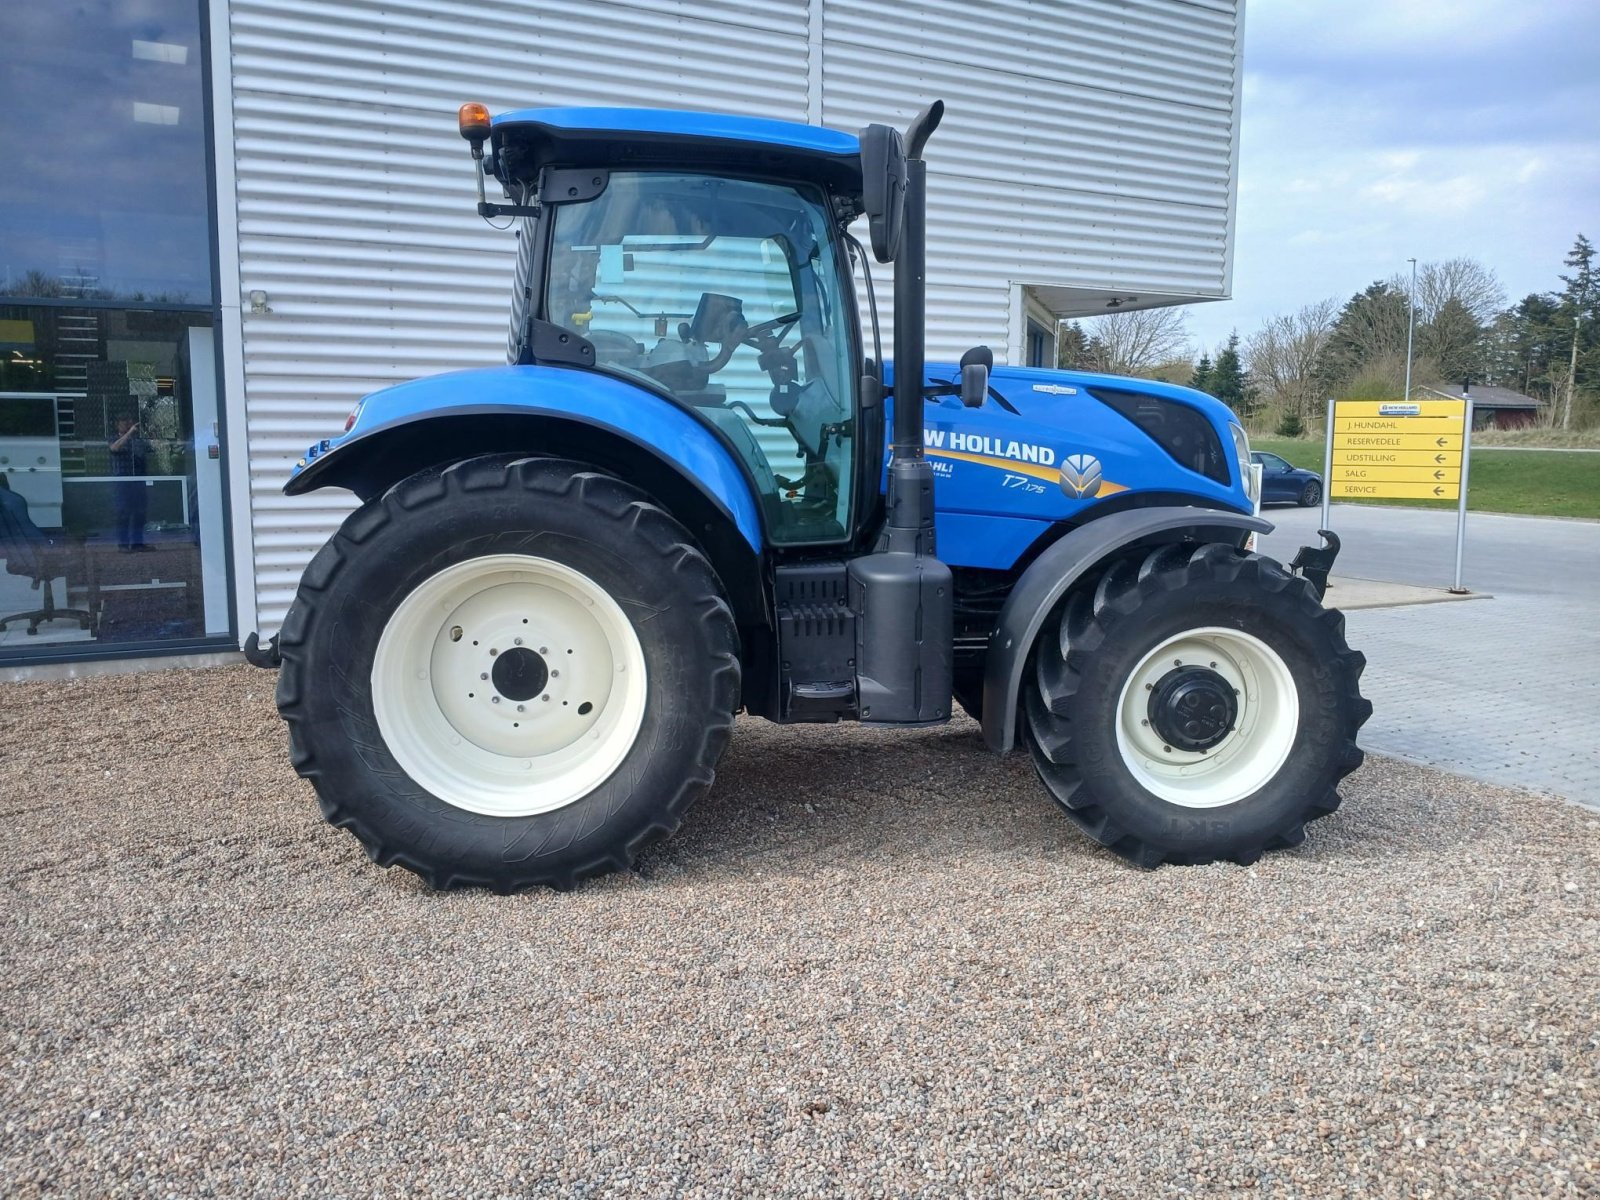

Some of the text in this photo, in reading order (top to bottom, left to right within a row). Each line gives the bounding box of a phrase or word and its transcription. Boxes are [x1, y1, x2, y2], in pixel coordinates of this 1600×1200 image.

[1347, 421, 1398, 430] J. HUNDAHL
[1347, 437, 1401, 446] RESERVEDELE
[949, 432, 1055, 466] HOLLAND
[1346, 454, 1396, 462] UDSTILLING
[1345, 470, 1367, 478] SALG
[1344, 485, 1377, 493] SERVICE
[1160, 817, 1232, 841] BKT
